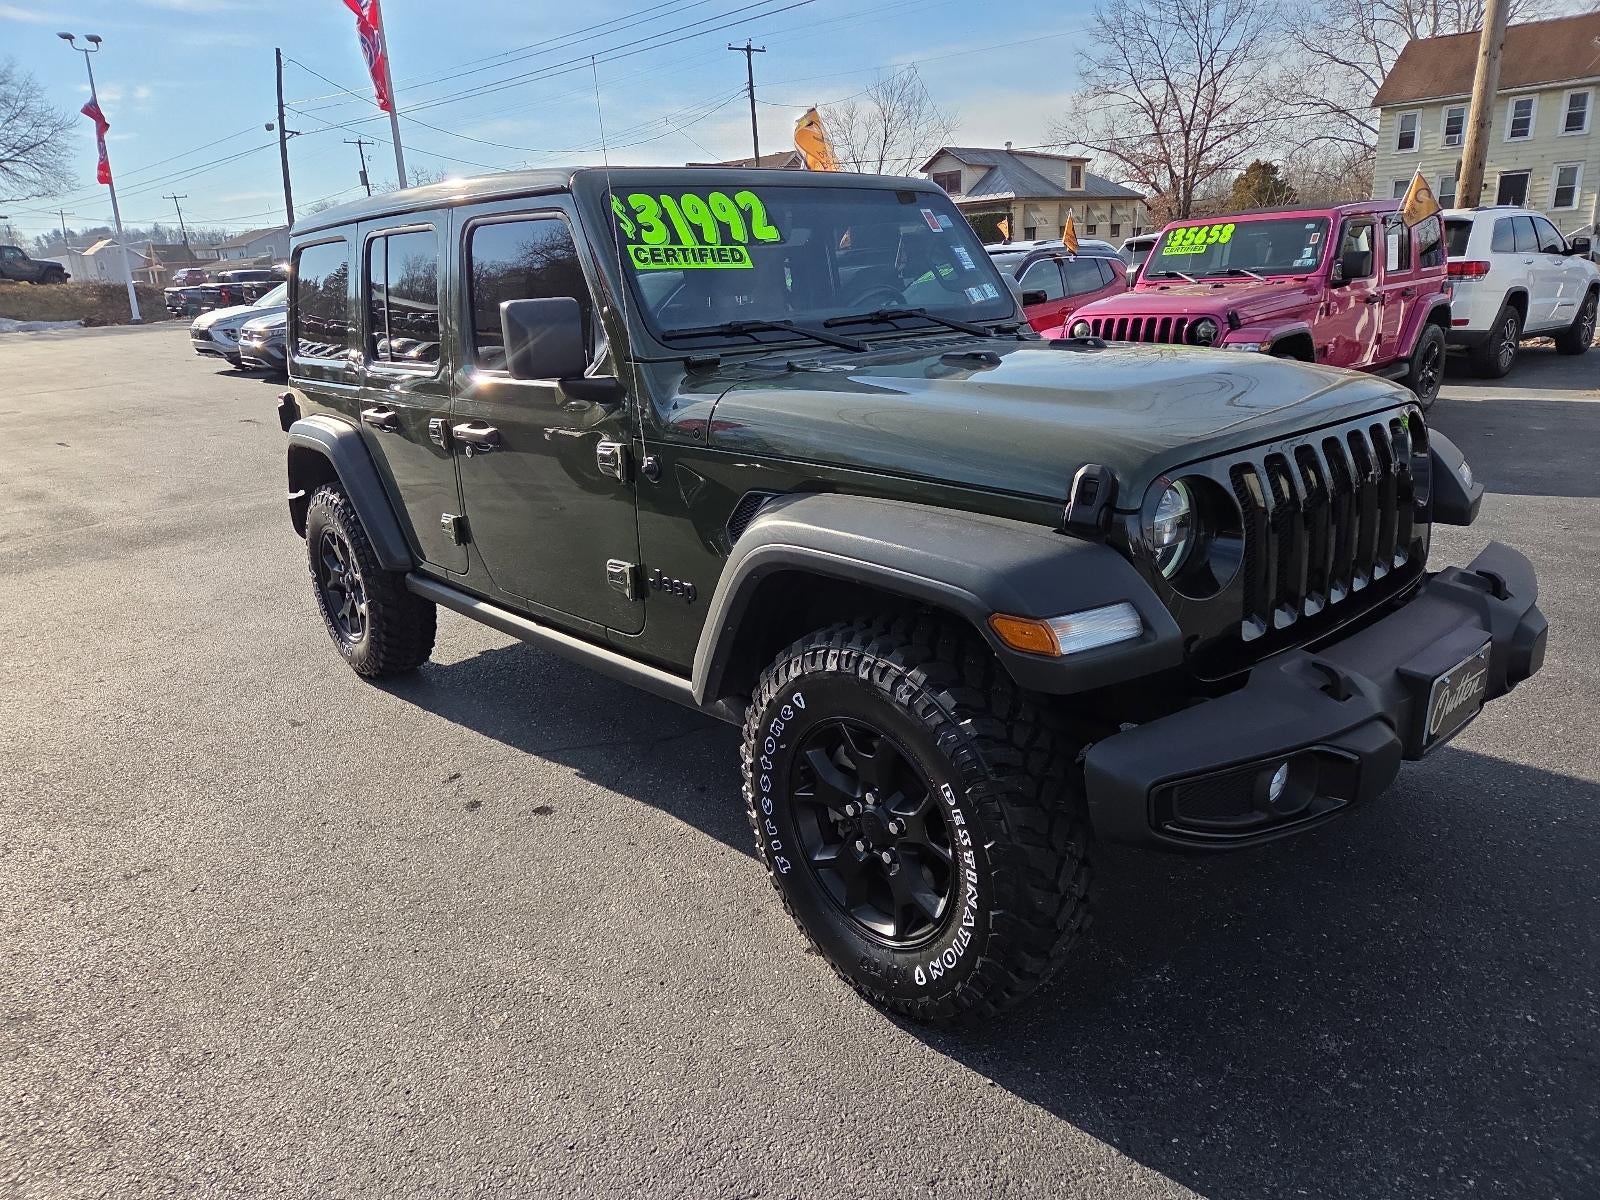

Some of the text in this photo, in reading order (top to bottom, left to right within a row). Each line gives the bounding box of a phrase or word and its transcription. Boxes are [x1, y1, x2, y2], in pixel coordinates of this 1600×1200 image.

[612, 191, 781, 246] $31992
[1167, 223, 1236, 247] $35658
[634, 246, 747, 266] CERTIFIED
[1164, 245, 1204, 254] CERTIFIED
[648, 568, 697, 603] Jeep
[760, 704, 794, 874] Firestone
[929, 782, 978, 981] DESTINATION
